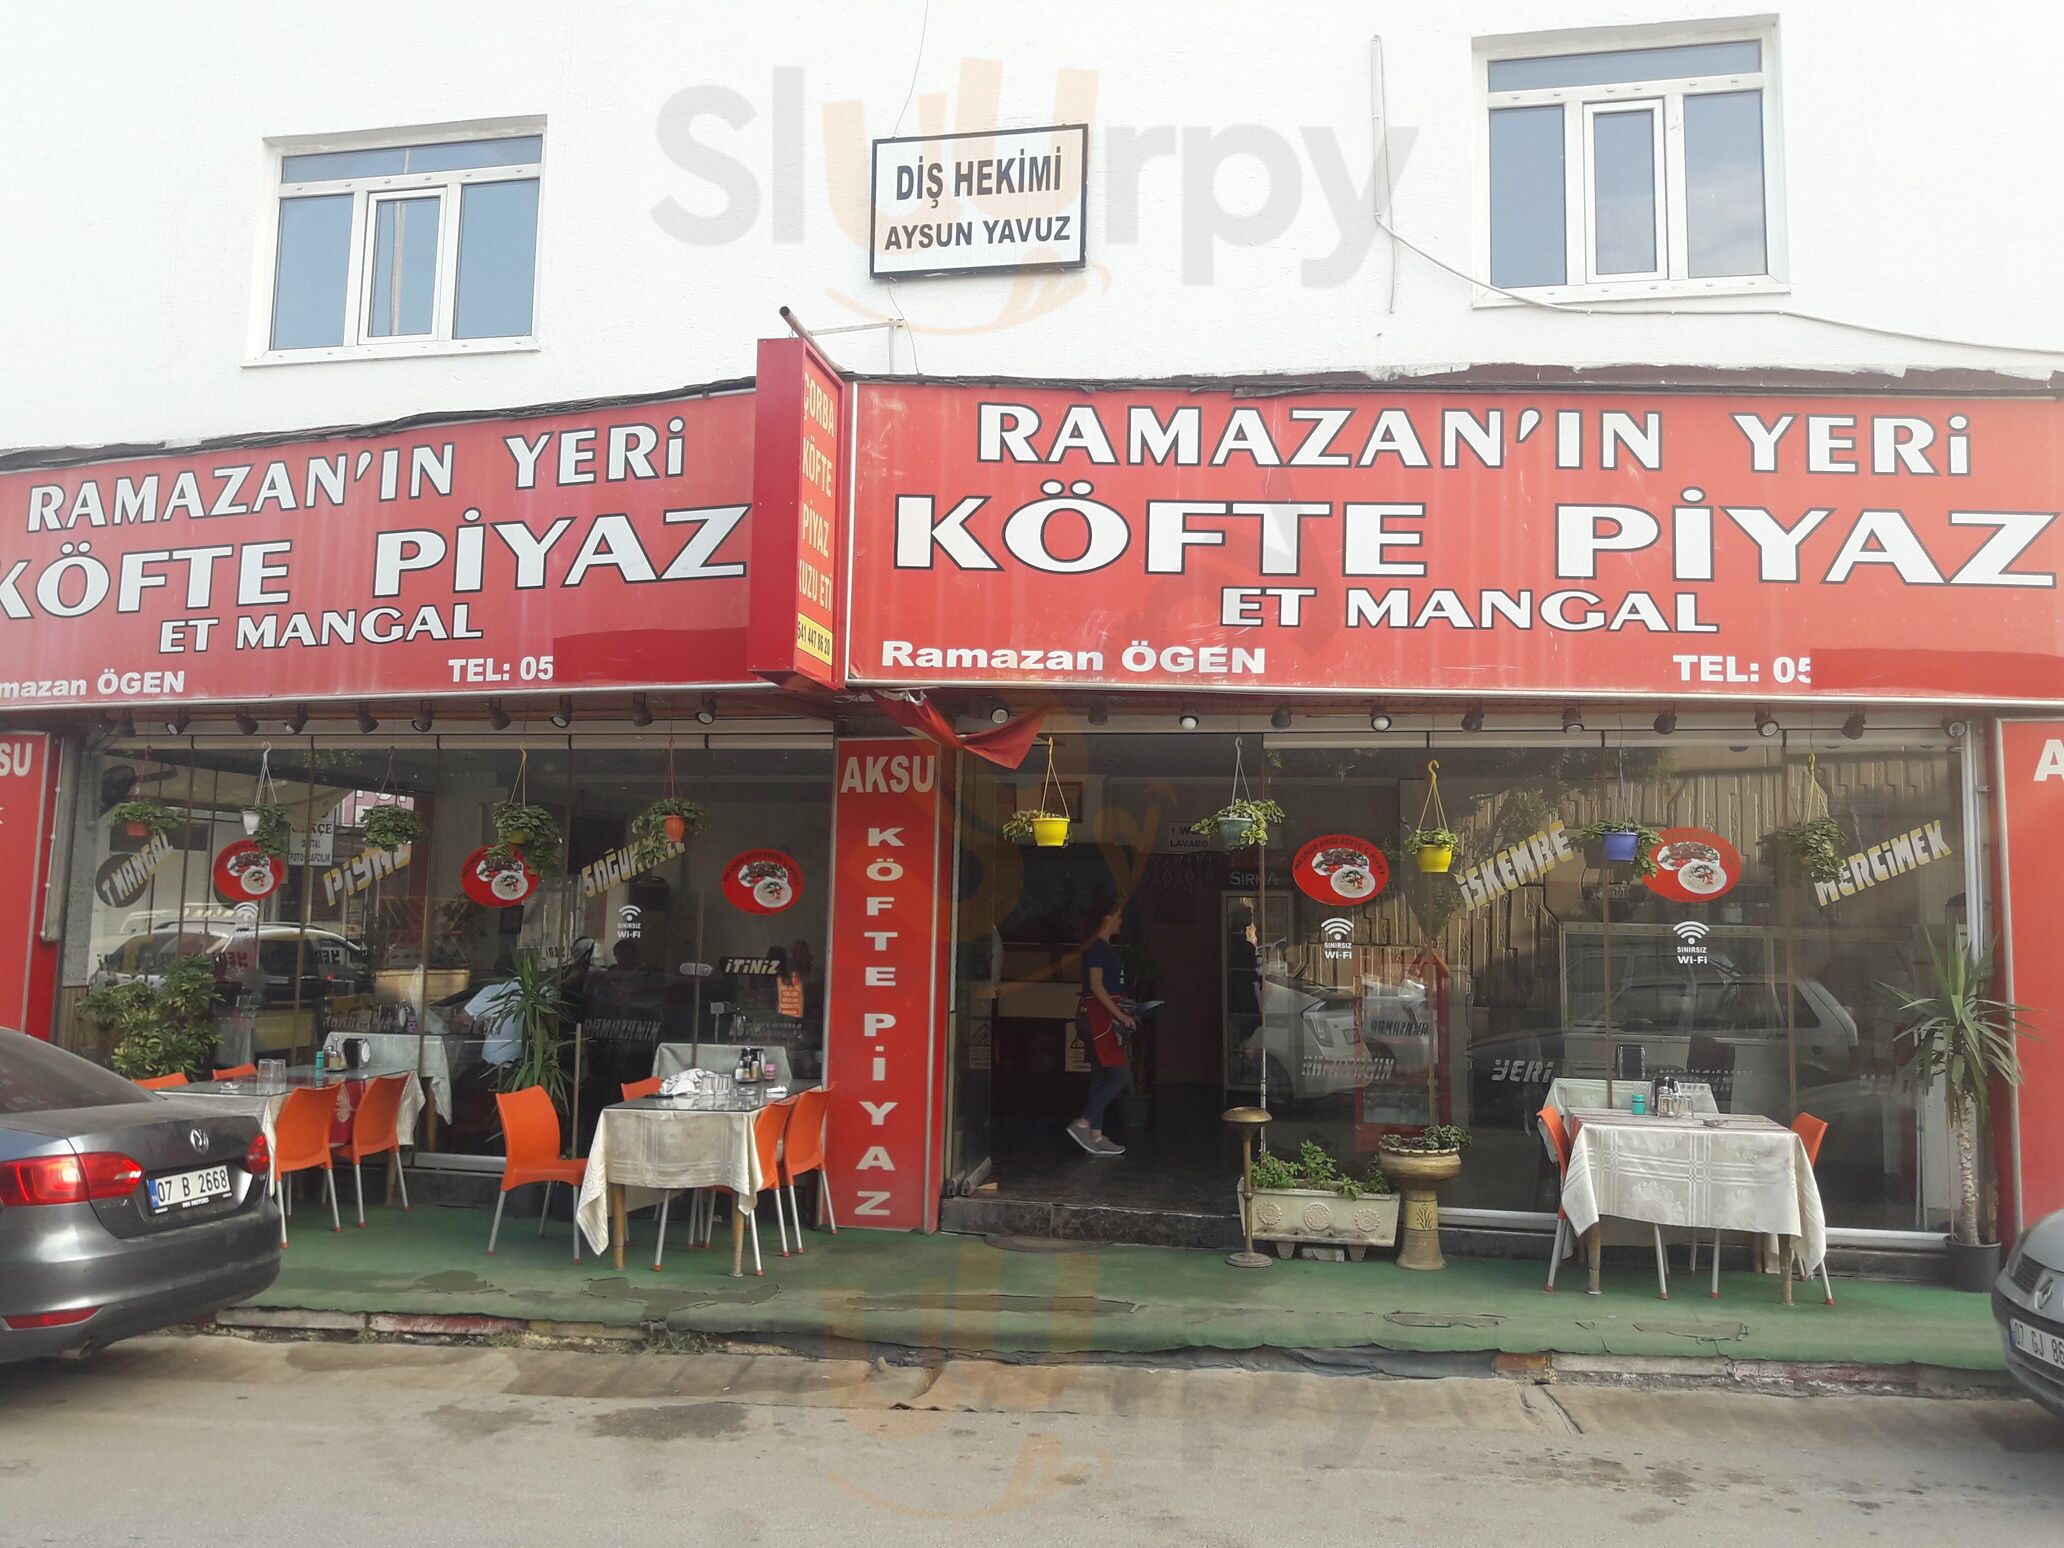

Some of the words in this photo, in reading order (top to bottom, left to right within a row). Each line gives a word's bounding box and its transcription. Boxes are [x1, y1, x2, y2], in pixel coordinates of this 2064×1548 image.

[896, 156, 943, 209] DİŞ
[954, 146, 1062, 197] HEKİMİ
[884, 221, 972, 250] AYSUN
[983, 216, 1071, 244] YAVUZ
[804, 371, 835, 438] ÇORBA
[977, 402, 1662, 471] RAMAZAN'IN
[27, 442, 455, 533] RAMAZAN'IN
[802, 437, 832, 498] KÖFTE
[373, 507, 752, 598] PİYAZ
[894, 479, 1428, 577] KÖFTE
[1555, 486, 2061, 589] PİYAZ
[158, 617, 219, 654] ET
[235, 603, 483, 650] MANGAL
[1220, 586, 1317, 628] ET
[1346, 587, 1720, 634] MANGAL
[97, 668, 185, 695] ÖGEN
[448, 658, 511, 682] TEL:
[520, 655, 554, 681] 05
[881, 640, 1103, 673] Ramazan
[1121, 640, 1265, 674] ÖGEN
[1673, 655, 1759, 682] TEL:
[840, 754, 935, 794] AKSU
[863, 827, 905, 987] KÖFTE
[854, 1012, 898, 1216] PİYAZ
[157, 1180, 172, 1202] 07
[182, 1177, 191, 1197] B
[198, 1169, 228, 1193] 2668
